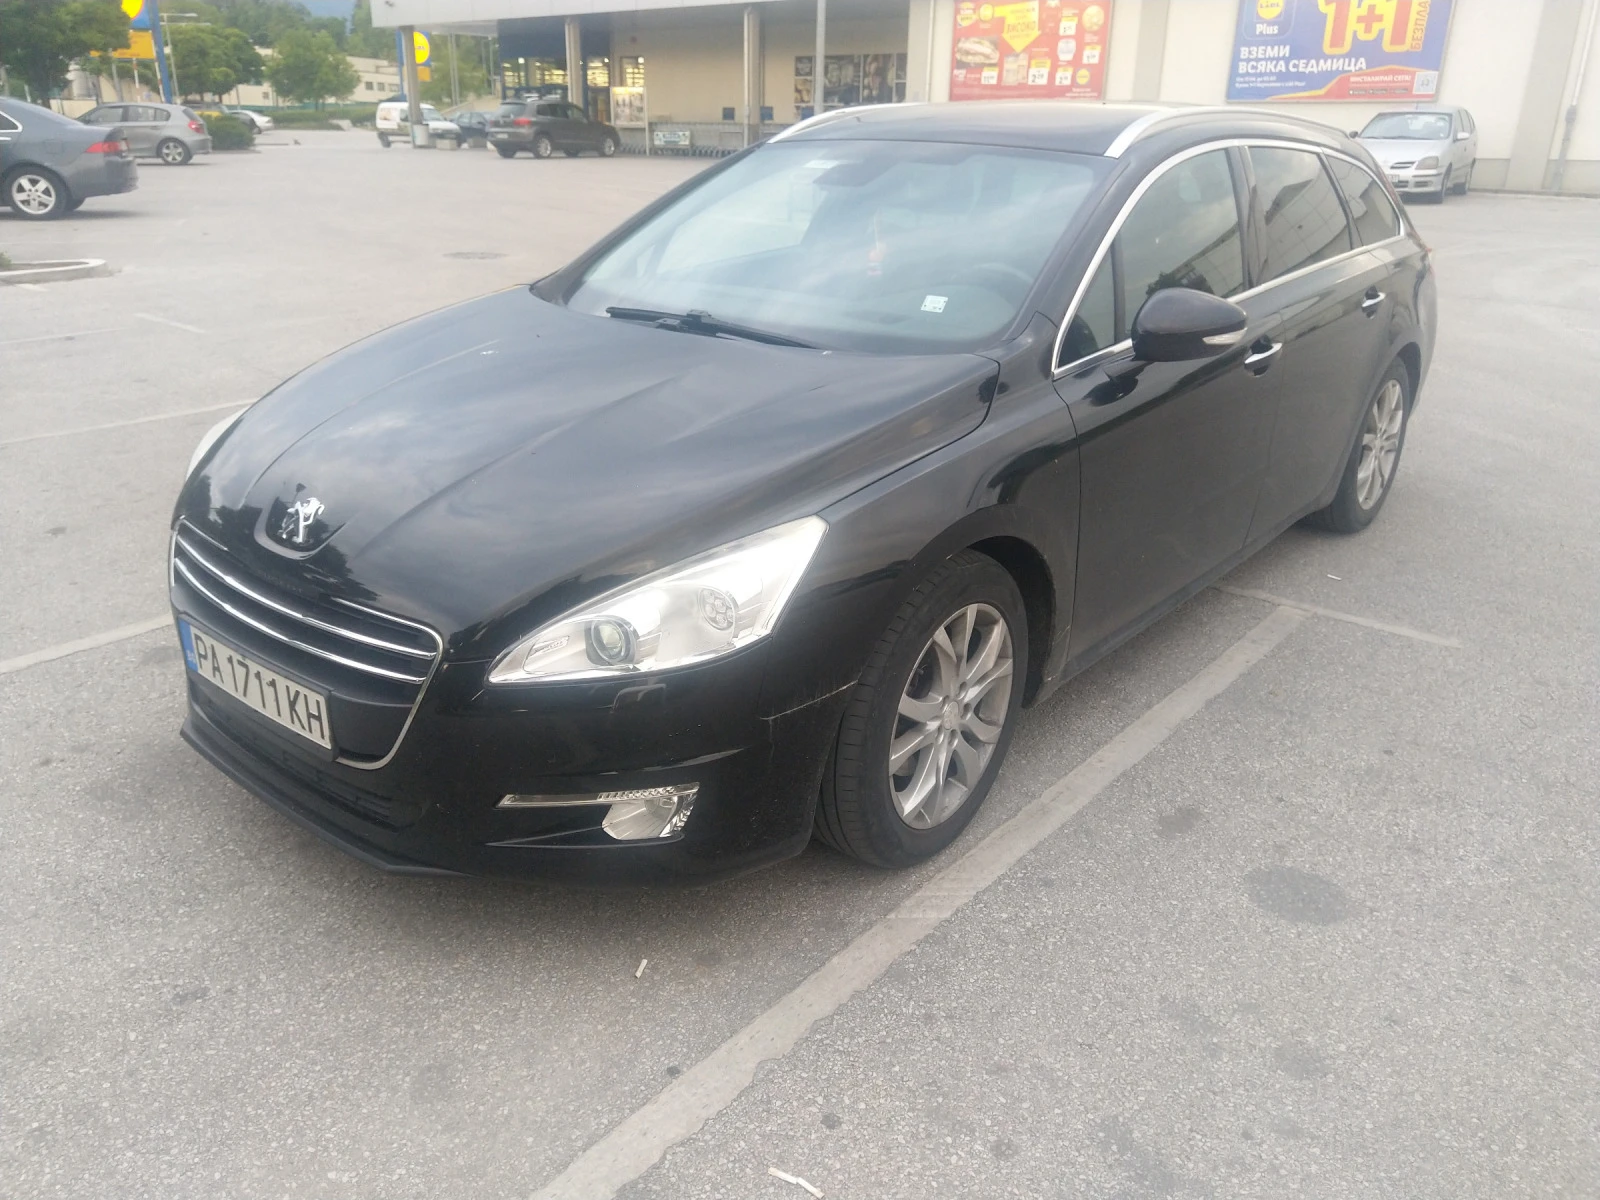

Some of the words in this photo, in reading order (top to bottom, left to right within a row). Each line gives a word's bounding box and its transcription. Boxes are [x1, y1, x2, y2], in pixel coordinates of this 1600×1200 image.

[1256, 24, 1279, 35] Plus
[1240, 45, 1290, 59] ВЗЕМИ
[1238, 60, 1286, 74] ВСЯКА
[1289, 57, 1367, 74] СЕДМИЦА
